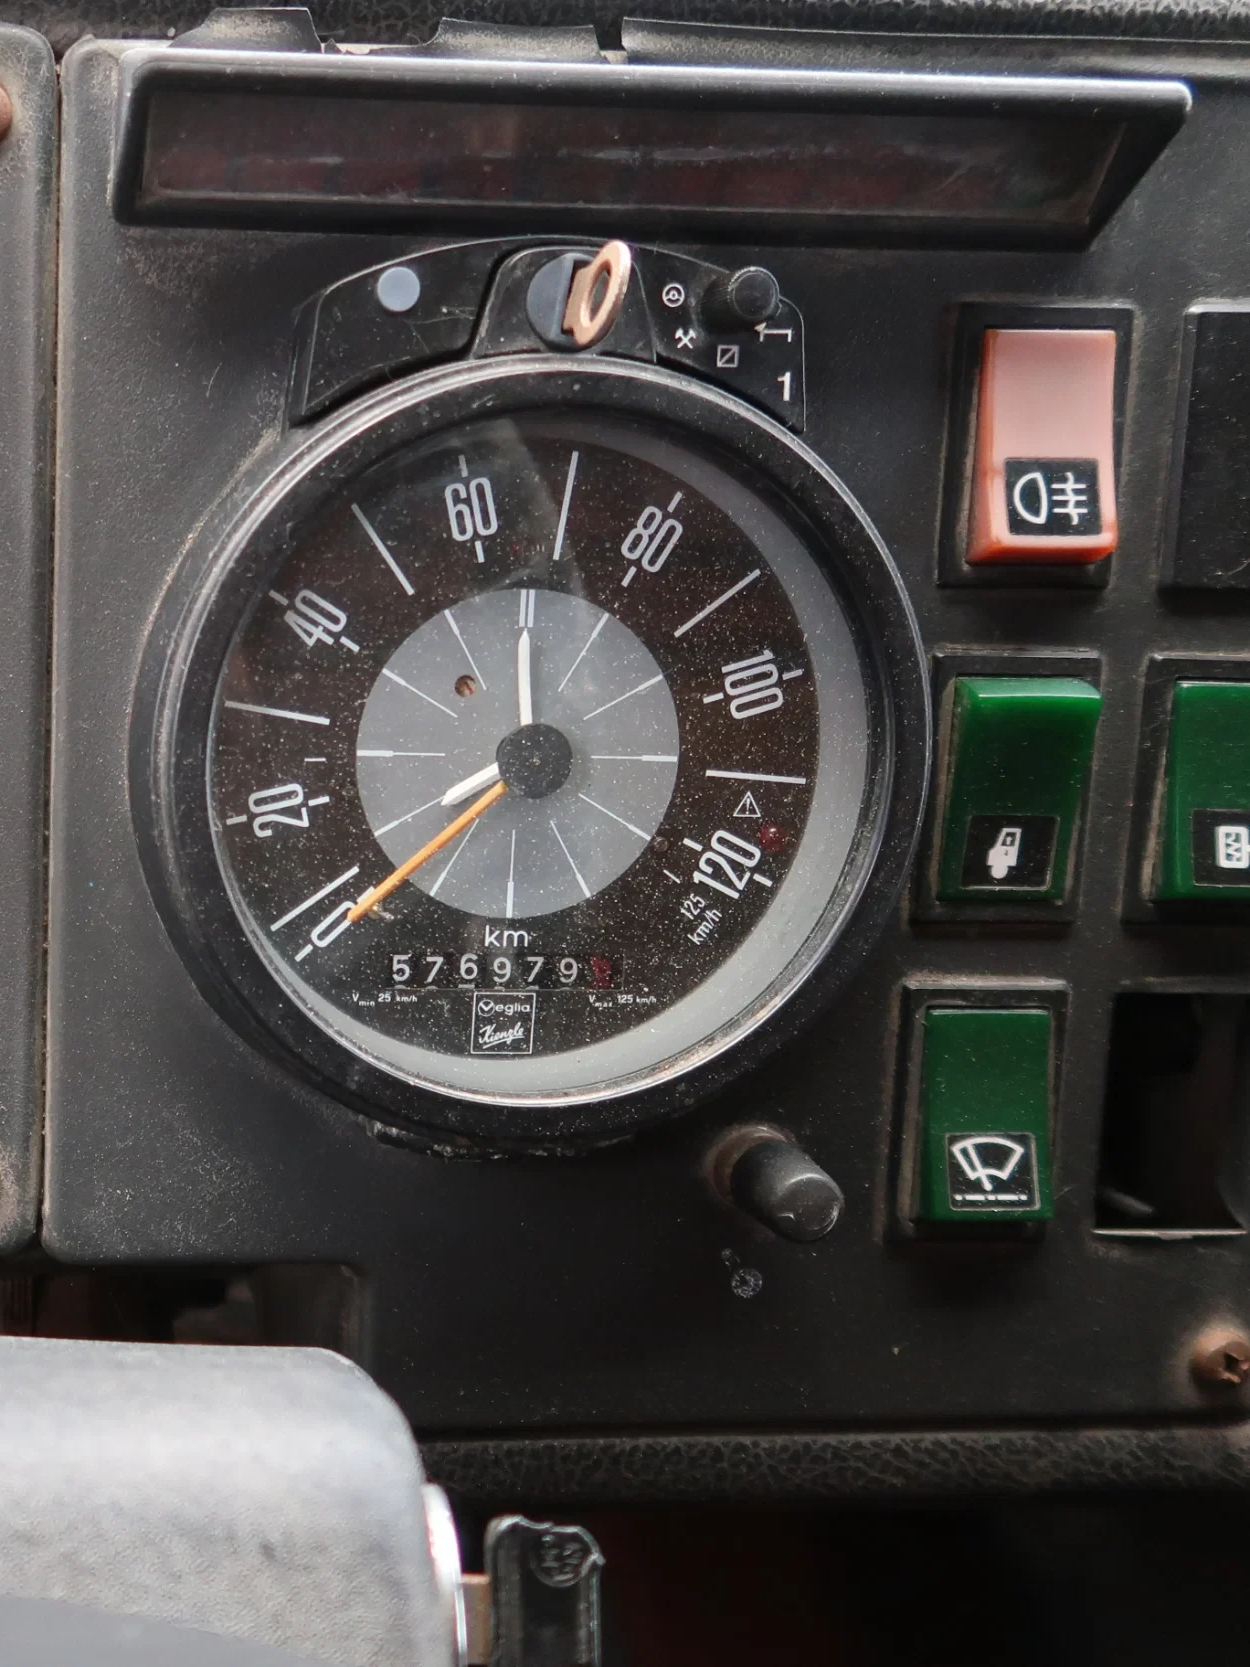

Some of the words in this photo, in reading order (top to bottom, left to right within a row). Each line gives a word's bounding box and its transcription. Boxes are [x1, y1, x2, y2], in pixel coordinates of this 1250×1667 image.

[777, 371, 791, 402] 1
[445, 477, 498, 543] 60
[622, 504, 682, 573] 80
[284, 589, 347, 649] 40
[722, 650, 784, 720] 100
[248, 783, 310, 838] 20
[693, 830, 761, 899] 120
[311, 901, 356, 948] 0
[680, 893, 706, 920] 125
[687, 908, 723, 946] km/h
[485, 925, 529, 947] km
[378, 993, 392, 1003] 25
[478, 999, 530, 1017] Veglia
[617, 994, 633, 1004] 125
